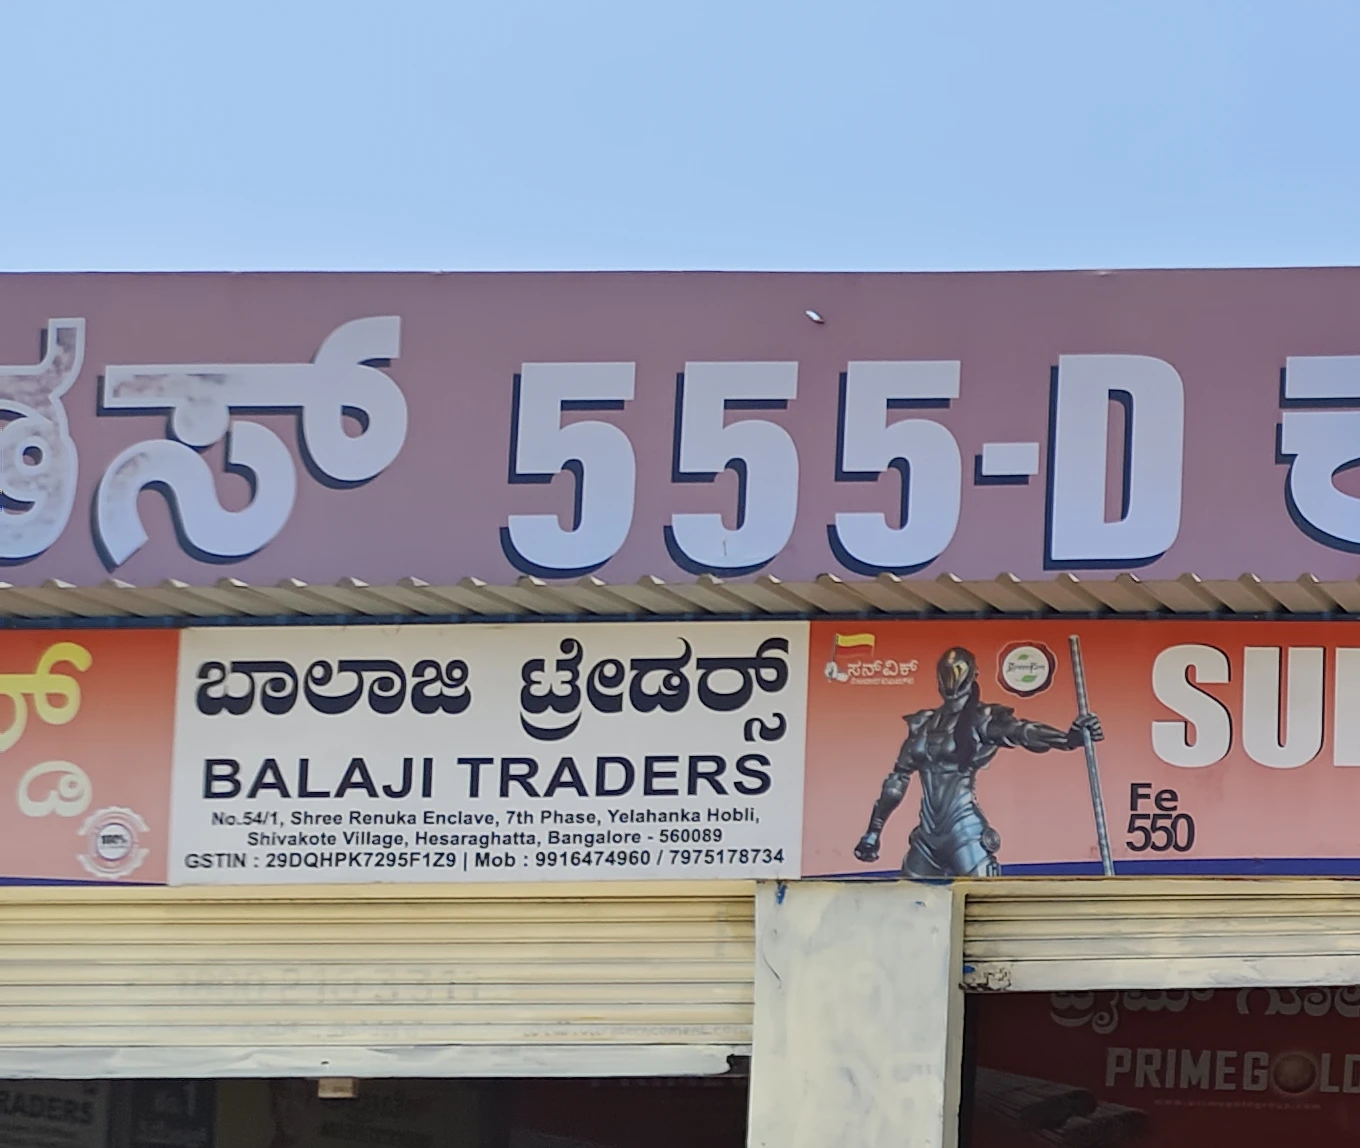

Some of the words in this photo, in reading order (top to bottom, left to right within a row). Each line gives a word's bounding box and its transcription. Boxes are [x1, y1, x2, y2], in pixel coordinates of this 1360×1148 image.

[504, 354, 1186, 570] 555-D
[195, 655, 472, 717] ಬಾಲಾಜಿ
[202, 755, 435, 800] BALAJI
[456, 752, 774, 799] TRADERS
[1129, 782, 1179, 812] Fe
[211, 811, 285, 828] No.54/1,
[290, 811, 343, 826] Shree
[349, 811, 417, 826] Renuka
[423, 810, 500, 828] Enclave,
[506, 809, 534, 825] 7th
[540, 809, 602, 827] Phase,
[607, 808, 701, 824] Yelahanka
[706, 807, 760, 824] Hobli,
[1126, 813, 1195, 853] 550
[247, 831, 337, 847] Shivakote
[341, 831, 409, 849] Village,
[415, 829, 542, 849] Hesaraghatta,
[547, 829, 641, 848] Bangalore
[659, 828, 723, 844] 560089
[184, 853, 247, 869] GSTIN
[265, 852, 457, 869] 29DQHPK7295F1Z9
[475, 852, 516, 868] Mob
[535, 850, 651, 867] 9916474960
[670, 848, 785, 865] 7975178734
